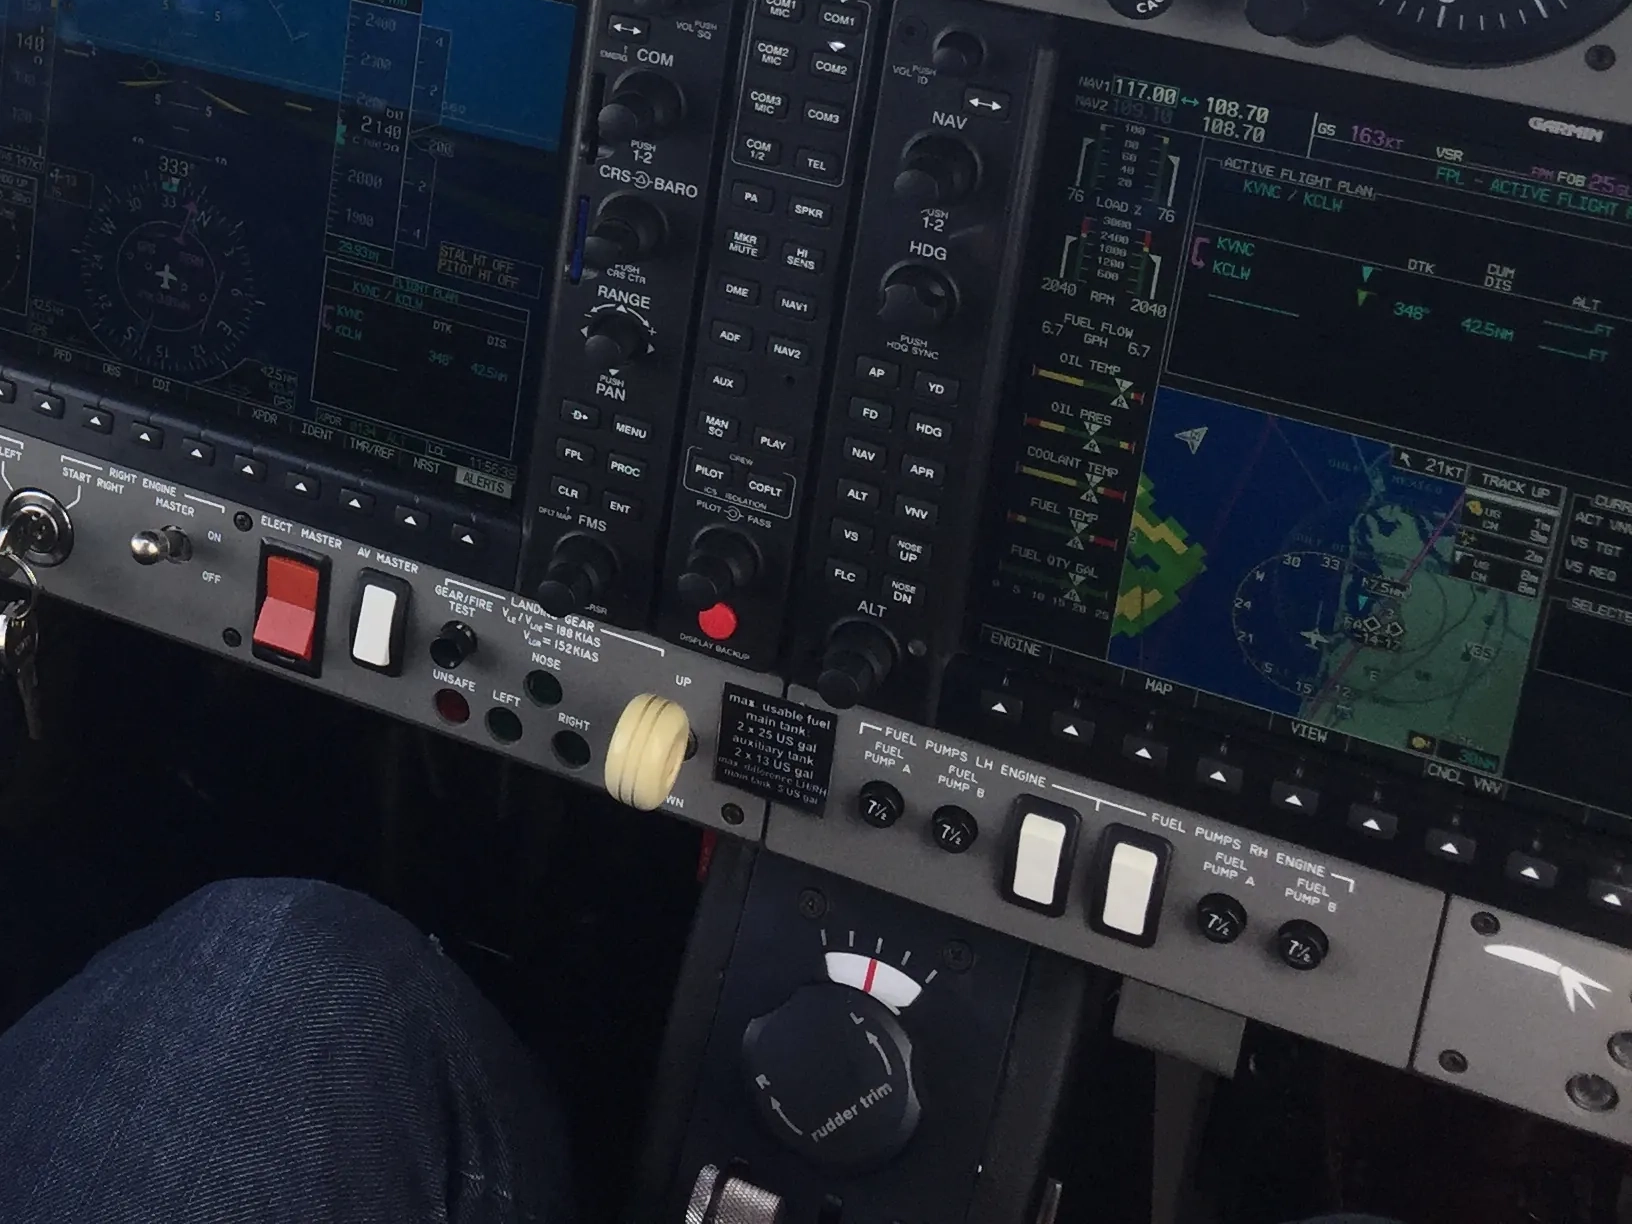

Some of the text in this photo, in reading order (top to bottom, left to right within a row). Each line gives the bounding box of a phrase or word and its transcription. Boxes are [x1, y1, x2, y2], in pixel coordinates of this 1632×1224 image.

[823, 11, 857, 26] COM1
[636, 47, 676, 68] COM
[757, 42, 790, 59] COM2
[814, 60, 849, 75] COM2
[750, 90, 784, 107] COM3
[1115, 77, 1271, 125] 117.00 108.70
[807, 108, 841, 125] COM3
[931, 110, 968, 131] NAV
[1202, 115, 1266, 144] 108.70
[1528, 115, 1606, 144] GARMIN
[806, 157, 828, 172] TEL
[1224, 156, 1333, 191] ACTIVE FLIGHT
[598, 164, 699, 200] CRS BARO
[1489, 177, 1620, 217] ACTIVE FLIGHT
[793, 204, 825, 221] SPKR
[440, 245, 516, 274] STAL OFF
[728, 241, 760, 257] MUTE
[908, 239, 949, 262] HDG
[437, 257, 521, 289] PITOT OFF
[786, 254, 817, 272] SENS
[597, 284, 652, 310] RANGE
[725, 283, 750, 299] DME
[779, 297, 809, 314] NAV1
[1129, 297, 1169, 319] 2040
[718, 328, 742, 344] ADF
[772, 342, 803, 360] NAV2
[595, 383, 628, 402] PAN
[712, 374, 736, 390] AUX
[615, 421, 648, 440] MENU
[915, 421, 944, 439] HDG
[0, 445, 24, 463] LEFT
[759, 435, 788, 452] PLAY
[300, 422, 506, 494] IDENT TMR/REF NRST ALERTS
[564, 447, 584, 463] FPL
[851, 447, 876, 463] NAV
[1026, 444, 1083, 470] COOLANT
[610, 460, 641, 479] PROC
[695, 462, 725, 481] PILOT
[96, 475, 126, 496] RIGHT
[108, 466, 178, 498] RIGHT ENGINE
[557, 483, 581, 500] CLR
[1481, 473, 1526, 496] TRACK
[155, 495, 197, 519] MASTER
[609, 499, 632, 515] ENT
[578, 514, 609, 533] FMS
[300, 528, 344, 551] MASTER
[375, 553, 420, 576] MASTER
[201, 570, 223, 585] OFF
[434, 583, 494, 614] GEAR/FIRE
[857, 599, 888, 619] ALT
[448, 599, 477, 620] TEST
[989, 633, 1043, 658] ENGINE
[531, 651, 562, 672] NOSE
[432, 668, 477, 693] UNSAFE
[1144, 678, 1174, 696] MAP
[491, 688, 522, 708] LEFT
[557, 711, 591, 732] RIGHT
[746, 711, 776, 728] main
[762, 702, 831, 730] usable fuel
[1289, 721, 1330, 745] VIEW
[776, 733, 818, 755] US gal
[874, 741, 905, 761] FUEL
[788, 751, 815, 767] tank
[863, 749, 896, 769] PUMP
[885, 726, 1047, 789] FUEL PUMPS LH ENGINE
[773, 759, 815, 781] US gal
[947, 764, 979, 785] FUEL
[1427, 762, 1465, 787] CNCL
[937, 775, 971, 793] PUMP
[1150, 812, 1327, 878] FUEL PUMPS ENGINE
[1202, 861, 1239, 881] PUMP
[1214, 851, 1249, 873] FUEL
[1284, 887, 1320, 907] PUMP
[1296, 877, 1331, 898] FUEL
[810, 1081, 893, 1144] rudder trim
